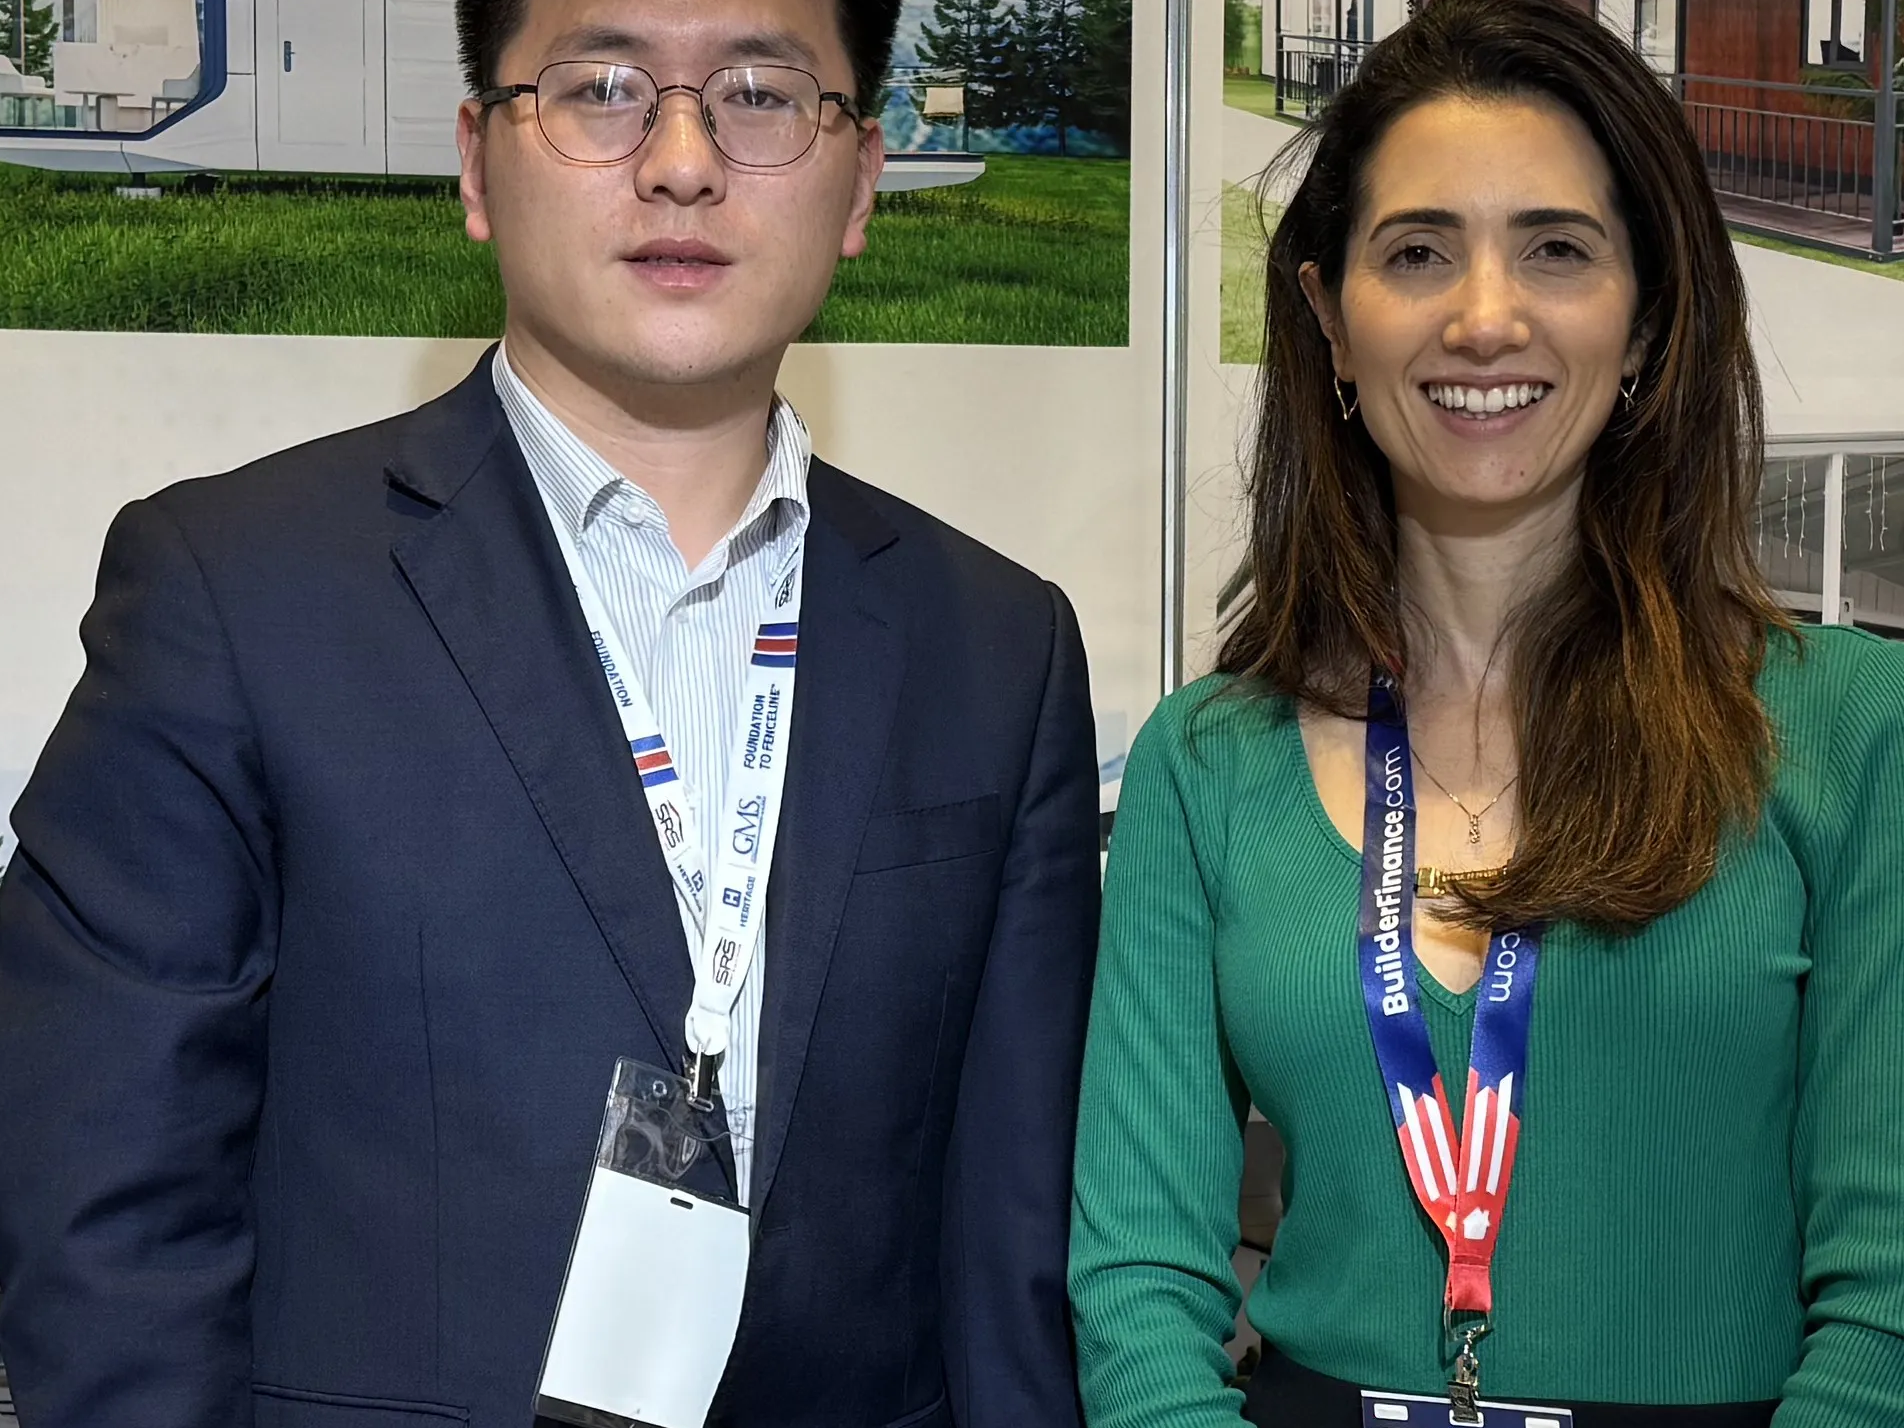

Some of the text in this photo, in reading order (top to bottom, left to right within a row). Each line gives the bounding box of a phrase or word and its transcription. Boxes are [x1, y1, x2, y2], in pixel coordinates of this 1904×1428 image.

[591, 630, 634, 708] FOUNDATION
[744, 693, 766, 770] FOUNDATION
[760, 750, 771, 770] TO
[655, 803, 681, 849] SRS
[740, 876, 756, 928] HERITAGE
[1373, 746, 1409, 1017] BuilderFinance.com
[716, 938, 736, 986] SRS
